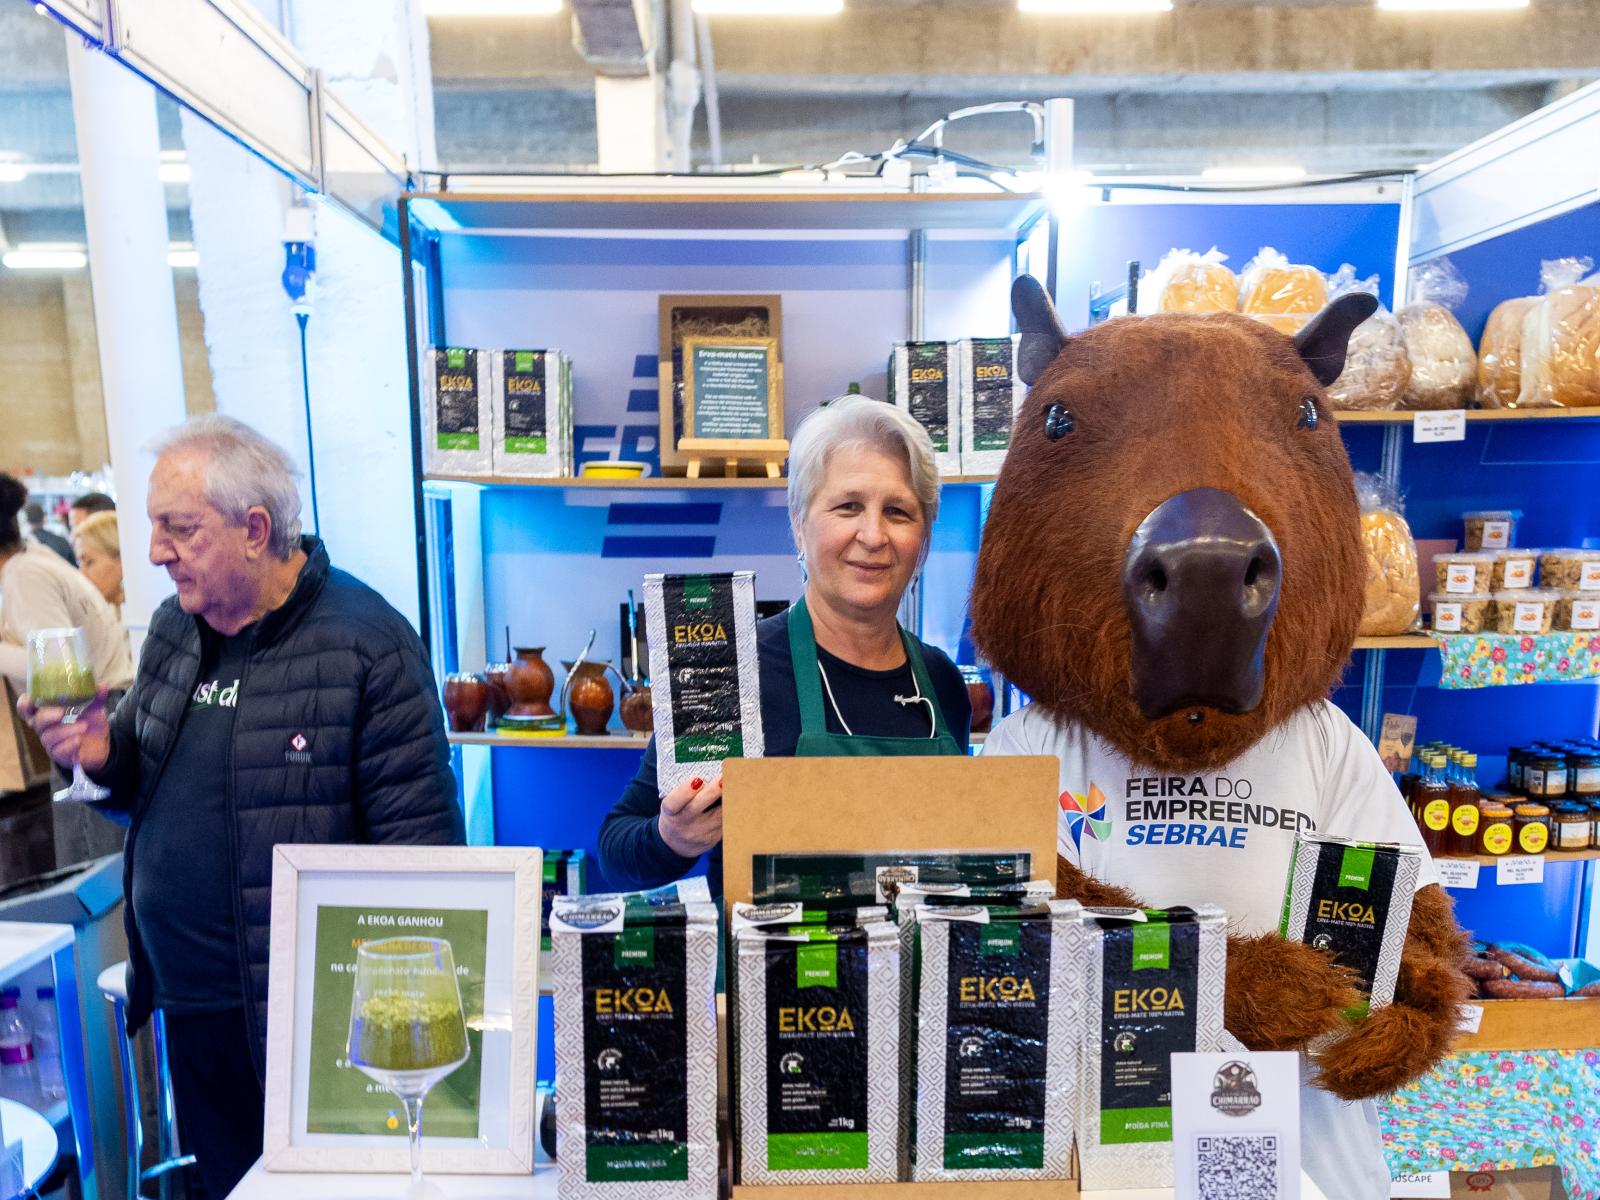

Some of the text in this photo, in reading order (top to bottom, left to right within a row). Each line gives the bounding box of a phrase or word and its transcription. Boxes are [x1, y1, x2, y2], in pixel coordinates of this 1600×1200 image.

[674, 622, 727, 643] EKOA
[1126, 777, 1253, 799] FEIRA DO
[1126, 799, 1316, 833] EMPREENDED
[1126, 823, 1249, 848] SEBRAE
[358, 915, 443, 927] A EKOA GANHOU
[1317, 899, 1376, 924] EKOA
[331, 963, 344, 972] no
[456, 965, 469, 976] de
[960, 976, 1036, 1002] EKOA
[595, 987, 673, 1013] EKOA
[1113, 987, 1185, 1013] EKOA
[778, 1006, 855, 1032] EKOA
[838, 1117, 855, 1129] 1kg
[1014, 1116, 1032, 1129] 1kg
[1150, 1120, 1169, 1130] FINA
[657, 1128, 675, 1141] 1kg
[1391, 1174, 1432, 1183] USCAPÉ
